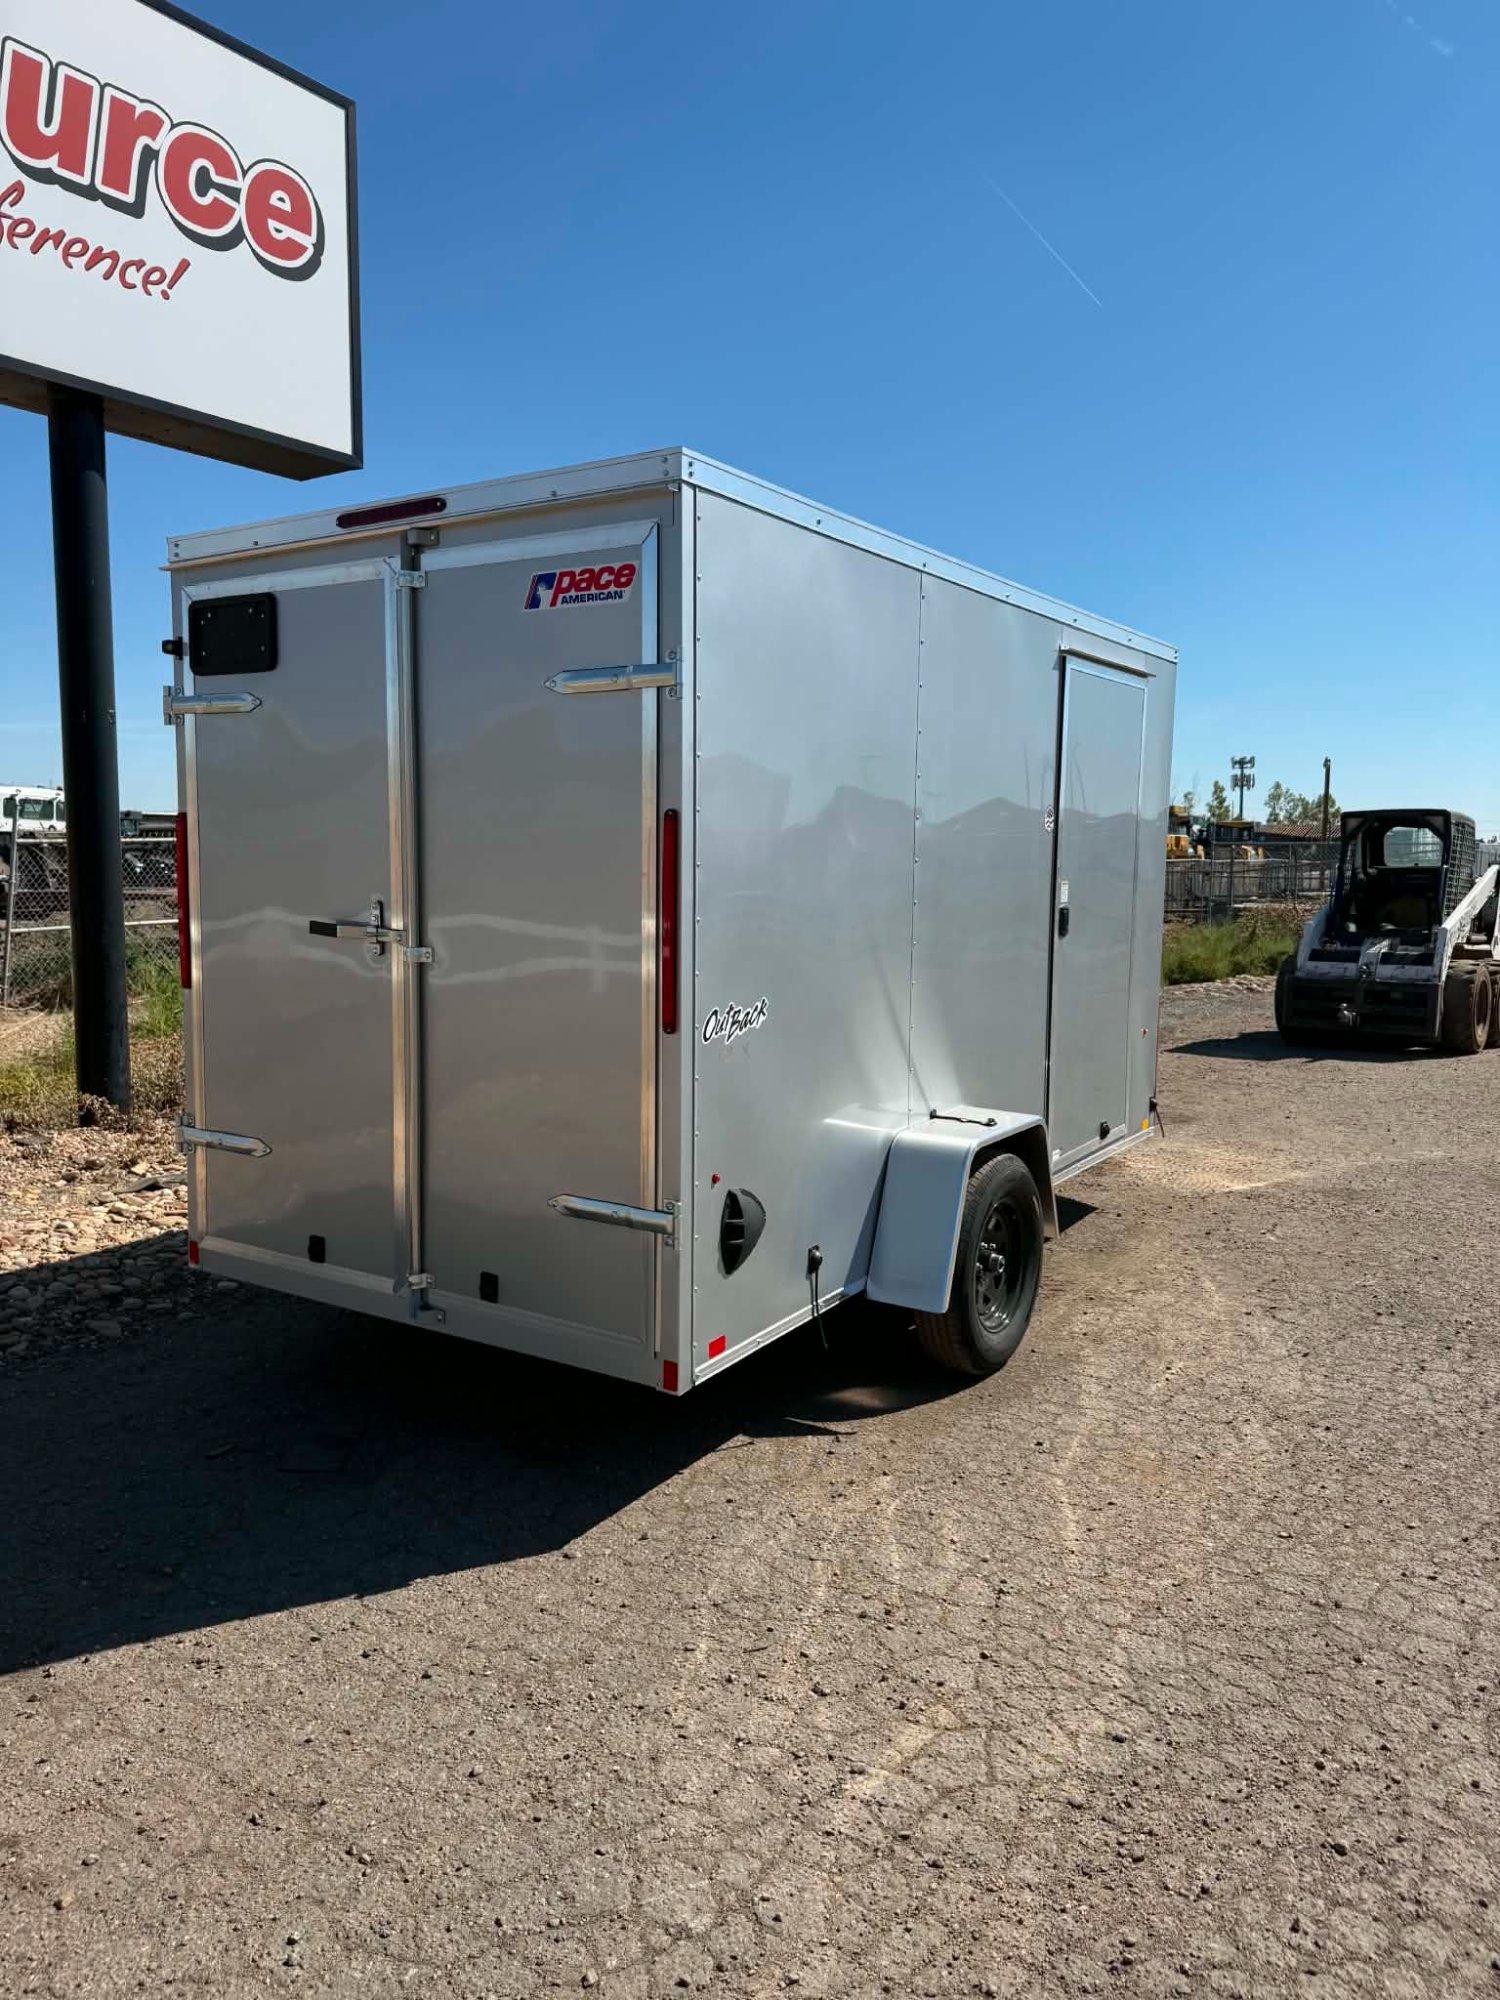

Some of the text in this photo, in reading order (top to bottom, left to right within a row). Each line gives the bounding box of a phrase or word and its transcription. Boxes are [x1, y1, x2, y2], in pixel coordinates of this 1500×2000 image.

[0, 36, 324, 281] urce
[550, 563, 637, 608] pace
[560, 589, 624, 605] AMERICAN
